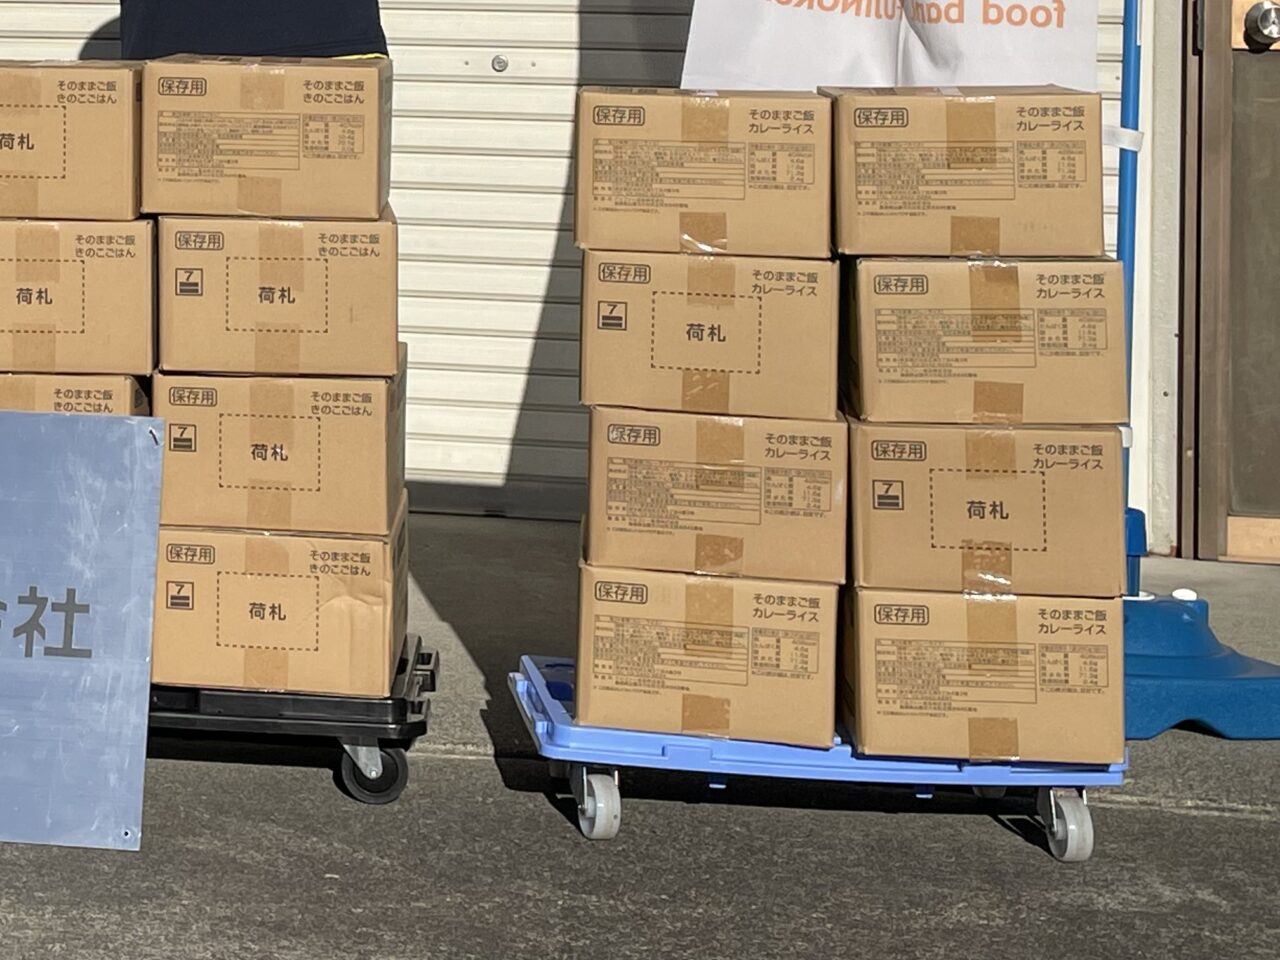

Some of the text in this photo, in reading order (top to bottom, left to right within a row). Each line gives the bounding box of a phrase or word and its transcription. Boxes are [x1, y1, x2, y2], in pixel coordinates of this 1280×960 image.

[56, 80, 118, 92] そのままご飯
[160, 79, 204, 94] 保存用
[302, 80, 364, 91] そのままご飯
[56, 93, 118, 104] きのこごはん
[302, 92, 364, 104] きのこごはん
[596, 108, 642, 124] 保存用
[748, 108, 816, 122] そのままご飯
[856, 110, 906, 126] 保存用
[1016, 106, 1086, 118] そのままご飯
[748, 122, 814, 134] カレーライス
[1016, 120, 1085, 132] カレーライス
[74, 234, 136, 246] そのままご飯
[178, 233, 222, 249] 保存用
[318, 232, 380, 245] そのままご飯
[74, 247, 136, 259] きのこごはん
[318, 246, 380, 258] きのこごはん
[600, 264, 648, 282] 保存用
[752, 268, 819, 284] そのままご飯
[1036, 273, 1104, 286] そのままご飯
[751, 282, 818, 296] カレーライス
[876, 276, 926, 292] 保存用
[16, 287, 54, 306] 荷札
[258, 286, 296, 305] 荷札
[1036, 287, 1105, 300] カレーライス
[686, 322, 727, 343] 荷札
[54, 388, 114, 400] そのままご飯
[172, 390, 215, 406] 保存用
[310, 391, 372, 404] そのままご飯
[54, 402, 114, 414] きのこごはん
[310, 404, 372, 416] きのこごはん
[610, 426, 658, 444] 保存用
[764, 432, 832, 448] そのままご飯
[250, 442, 288, 462] 荷札
[764, 446, 832, 462] カレーライス
[874, 442, 924, 459] 保存用
[1032, 444, 1104, 457] そのままご飯
[1032, 458, 1104, 470] カレーライス
[966, 500, 1010, 520] 荷札
[170, 546, 213, 562] 保存用
[309, 550, 372, 564] そのままご飯
[309, 564, 372, 577] きのこごはん
[598, 582, 646, 602] 保存用
[752, 593, 821, 610] そのままご飯
[248, 602, 287, 622] 荷札
[752, 608, 820, 624] カレーライス
[878, 606, 927, 624] 保存用
[1038, 608, 1108, 622] そのままご飯
[1038, 623, 1107, 636] カレーライス
